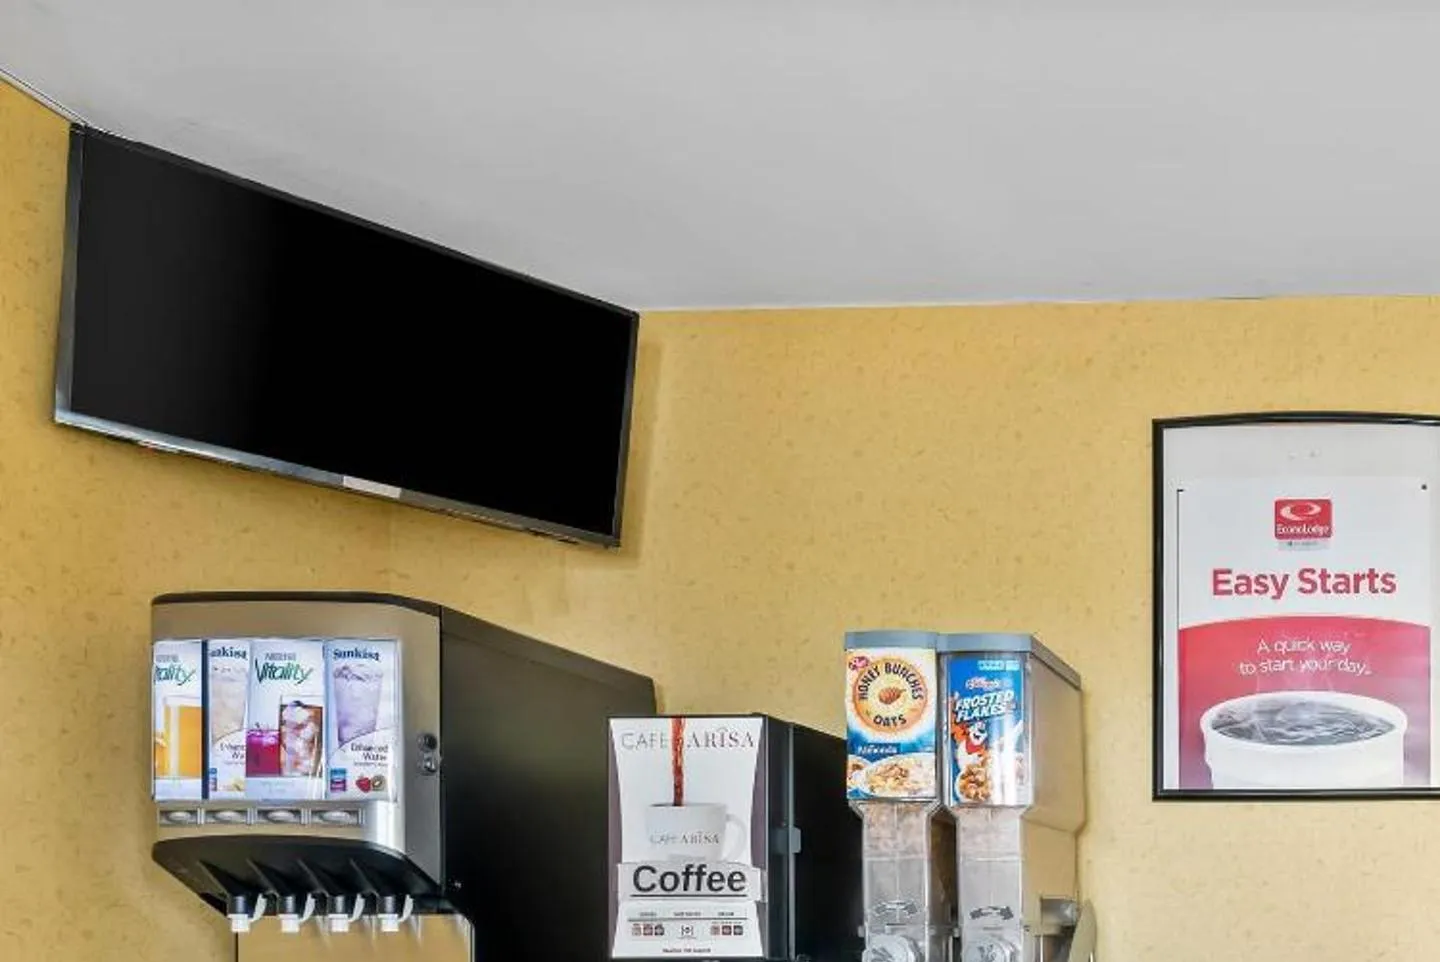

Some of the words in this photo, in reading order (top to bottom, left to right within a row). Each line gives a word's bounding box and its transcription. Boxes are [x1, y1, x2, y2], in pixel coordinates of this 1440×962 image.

[1211, 567, 1290, 600] Easy
[1297, 567, 1397, 595] Starts
[1257, 639, 1270, 654] A
[1274, 637, 1316, 655] quick
[255, 657, 314, 684] Vitality
[1240, 661, 1256, 675] to
[1259, 658, 1294, 673] start
[1299, 659, 1334, 673] your
[857, 664, 881, 701] HONEY
[884, 661, 924, 701] BUNCHES
[956, 690, 1014, 712] FROSTED
[872, 713, 908, 727] OATS
[632, 863, 747, 893] Coffee
